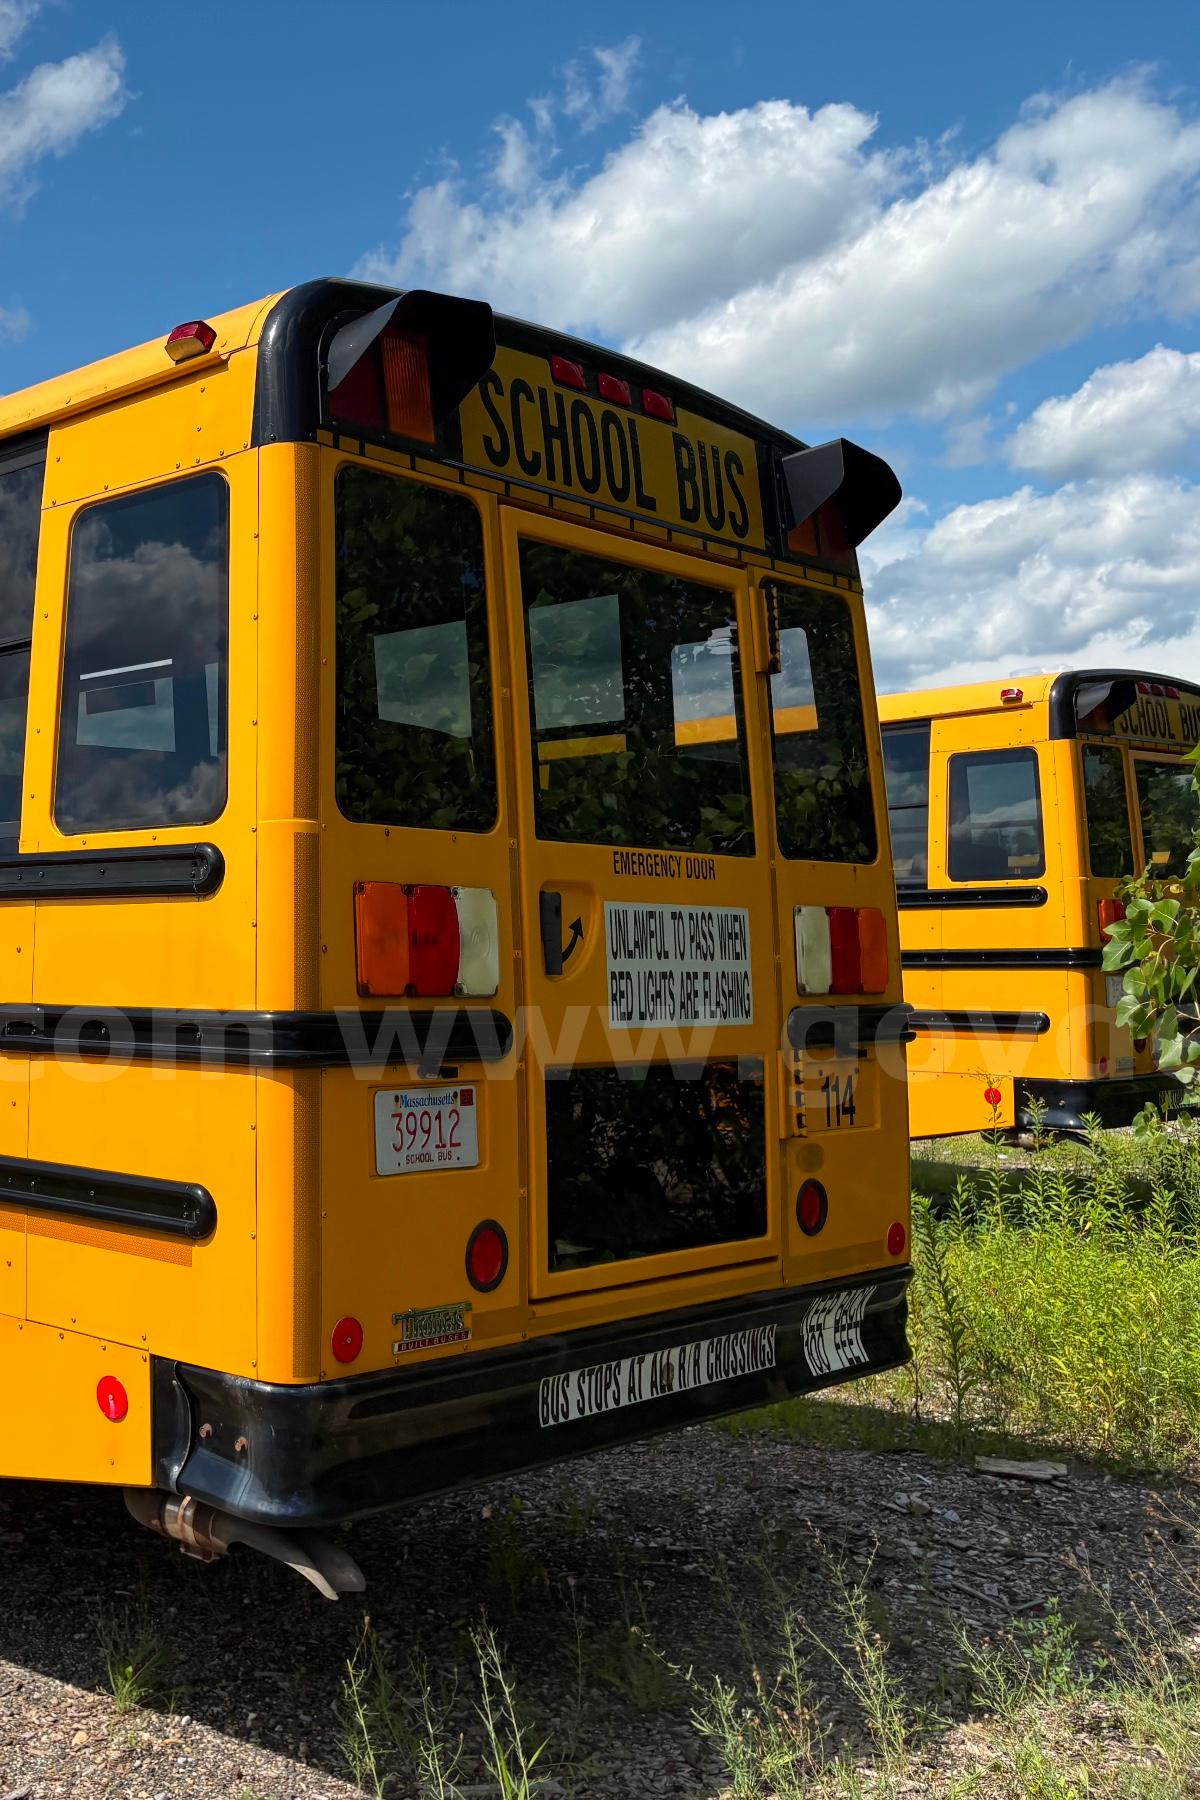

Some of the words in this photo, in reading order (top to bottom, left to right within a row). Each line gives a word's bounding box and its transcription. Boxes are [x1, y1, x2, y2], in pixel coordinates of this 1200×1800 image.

[479, 368, 657, 511] SCHOOL
[672, 430, 750, 538] BUS
[613, 851, 682, 878] EMERGENCY
[686, 857, 716, 880] DOOR
[609, 909, 669, 960] UNLAWFUL
[671, 910, 686, 960] TO
[688, 911, 715, 962] PASS
[717, 913, 747, 961] WHEN
[610, 971, 634, 1021] RED
[637, 970, 676, 1021] LIGHTS
[679, 971, 699, 1020] ARE
[702, 970, 751, 1020] FLASHING
[399, 1093, 455, 1108] Massachusetts
[821, 1075, 856, 1127] 114
[391, 1108, 462, 1152] 39912
[405, 1152, 434, 1165] SCHOOL
[437, 1150, 452, 1161] BUS
[401, 1339, 430, 1351] BUILT
[433, 1333, 466, 1345] BUSES
[803, 1332, 832, 1375] 100
[834, 1321, 869, 1368] FEET
[541, 1372, 570, 1425] BUS
[576, 1360, 621, 1416] STOPS
[627, 1355, 646, 1402] AT
[650, 1349, 674, 1396] ALL
[678, 1342, 702, 1389] R/R
[706, 1324, 777, 1382] CROSSINGS
